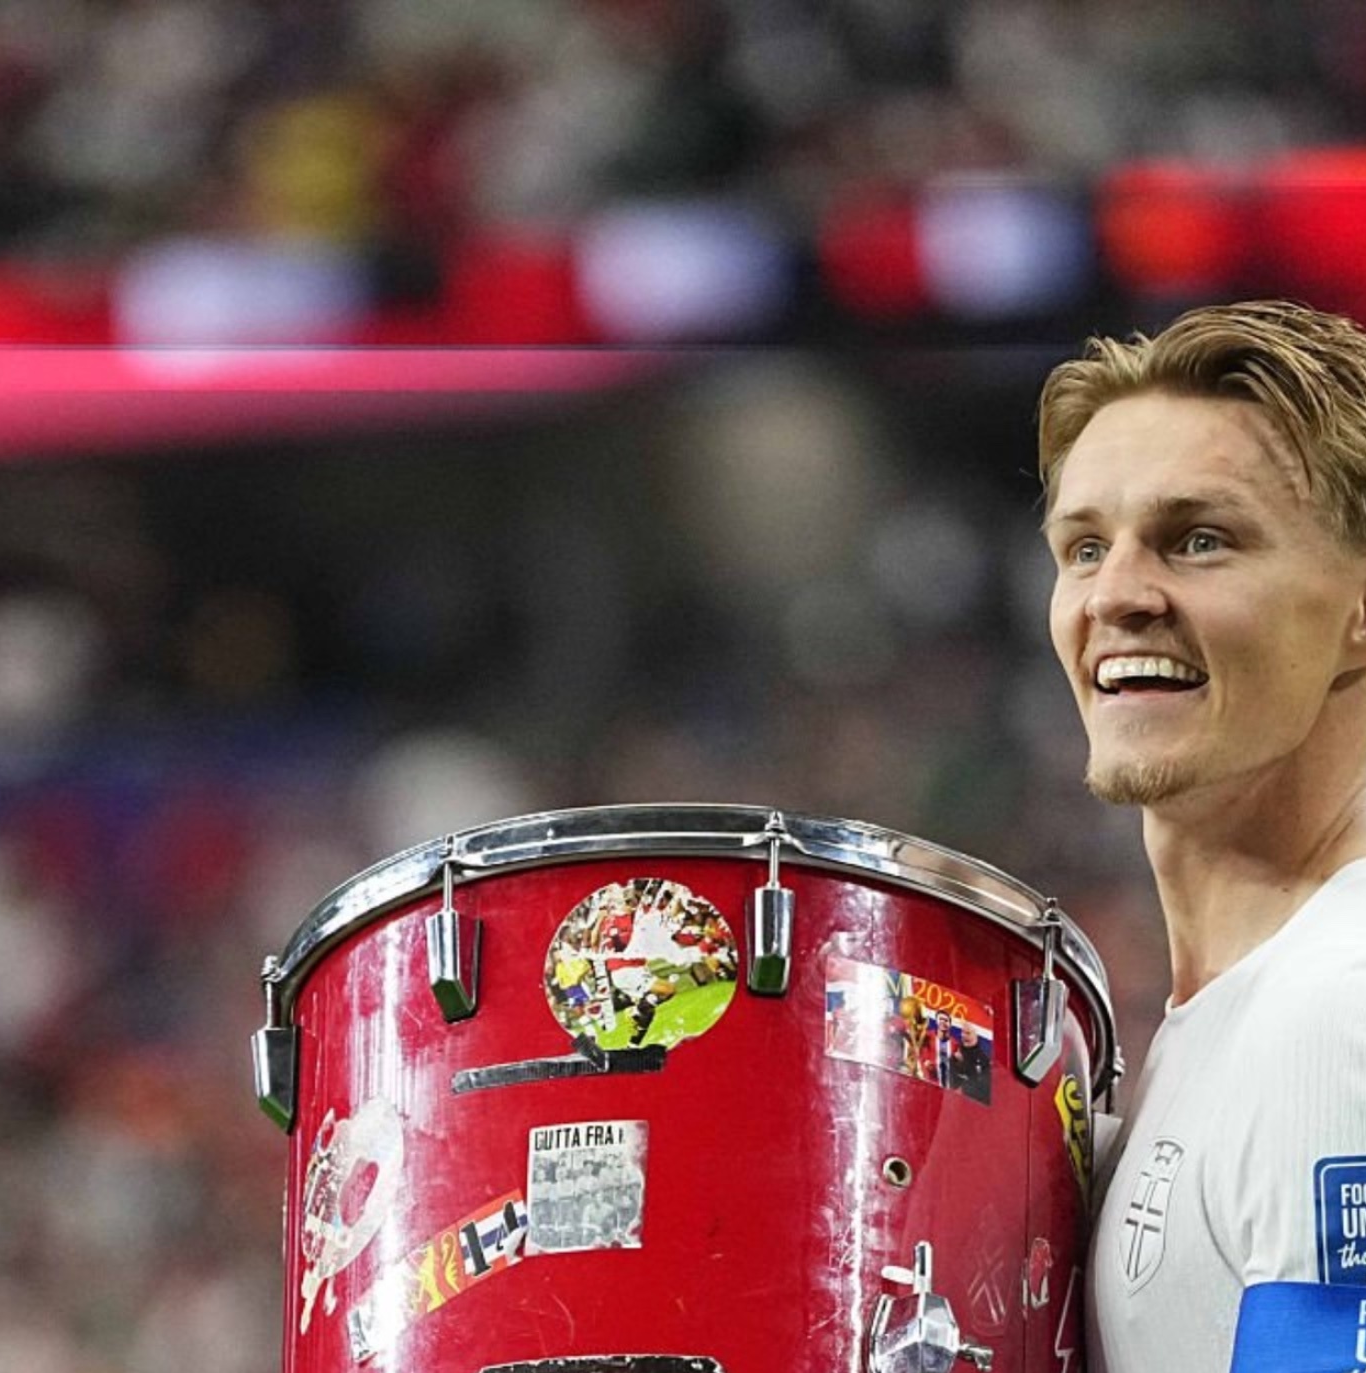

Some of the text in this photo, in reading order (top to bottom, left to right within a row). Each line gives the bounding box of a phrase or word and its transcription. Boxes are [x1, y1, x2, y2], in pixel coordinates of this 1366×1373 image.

[912, 978, 968, 1023] 2026
[535, 1127, 581, 1151] GUTTA
[585, 1125, 615, 1146] FRA
